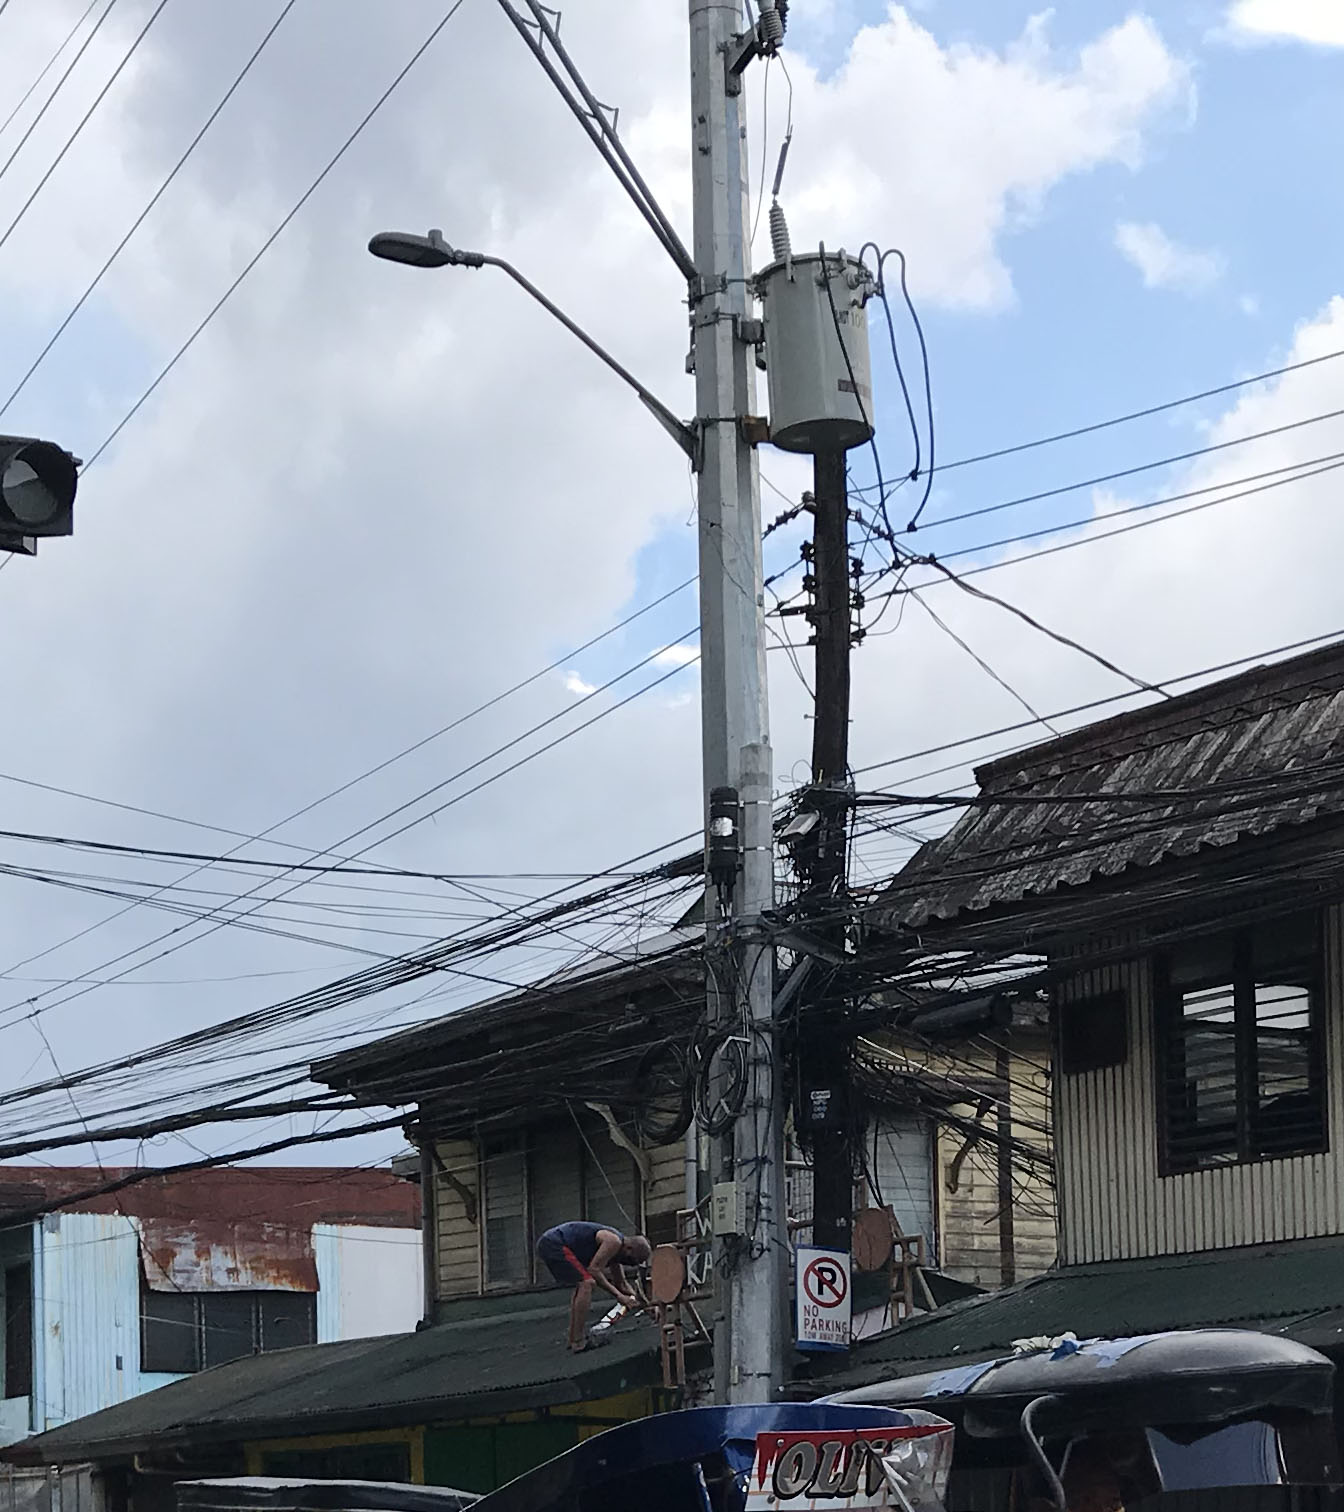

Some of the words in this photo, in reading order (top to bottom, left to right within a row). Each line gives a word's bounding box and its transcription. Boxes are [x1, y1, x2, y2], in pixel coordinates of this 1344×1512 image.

[804, 1305, 819, 1318] NO
[804, 1318, 848, 1334] PARKING
[773, 1438, 918, 1500] OLIV
